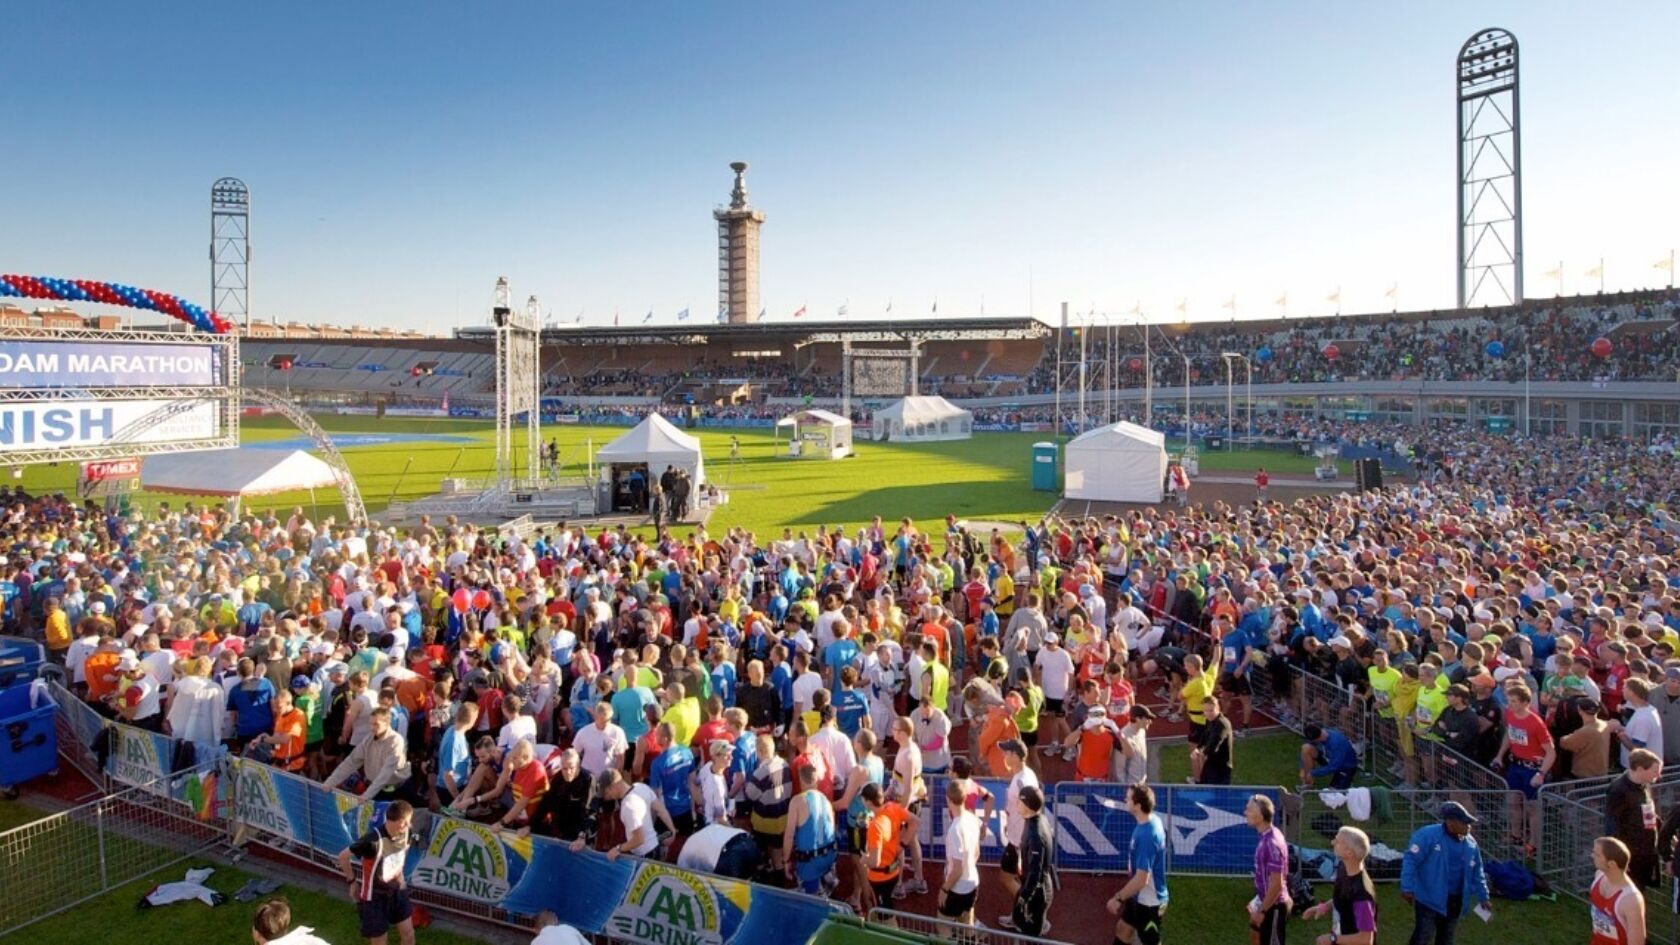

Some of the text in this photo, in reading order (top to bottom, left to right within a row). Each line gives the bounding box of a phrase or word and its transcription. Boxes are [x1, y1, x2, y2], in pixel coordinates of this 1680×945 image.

[68, 353, 208, 374] MARATHON
[90, 462, 138, 477] TIMEX
[445, 837, 488, 881] AA
[434, 867, 493, 900] DRINK
[648, 885, 697, 932] AA
[633, 918, 703, 945] DRINK
